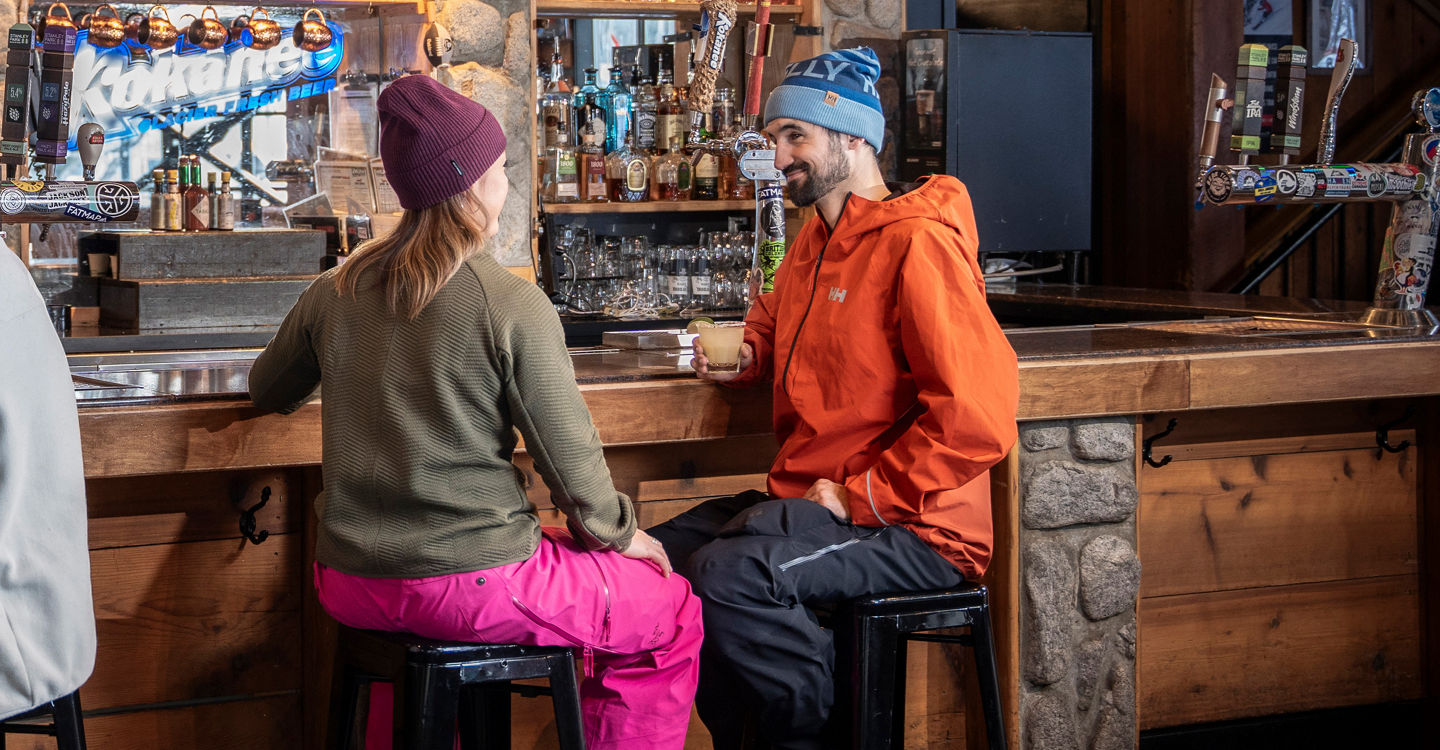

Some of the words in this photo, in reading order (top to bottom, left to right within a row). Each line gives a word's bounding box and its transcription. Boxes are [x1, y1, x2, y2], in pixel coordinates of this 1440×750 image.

[710, 11, 732, 69] Kokanee
[786, 60, 851, 81] LLY
[287, 78, 337, 101] BEER
[48, 190, 85, 200] JACKSON
[758, 188, 782, 198] FATMA
[67, 205, 101, 220] FATMAP
[828, 286, 848, 303] HH
